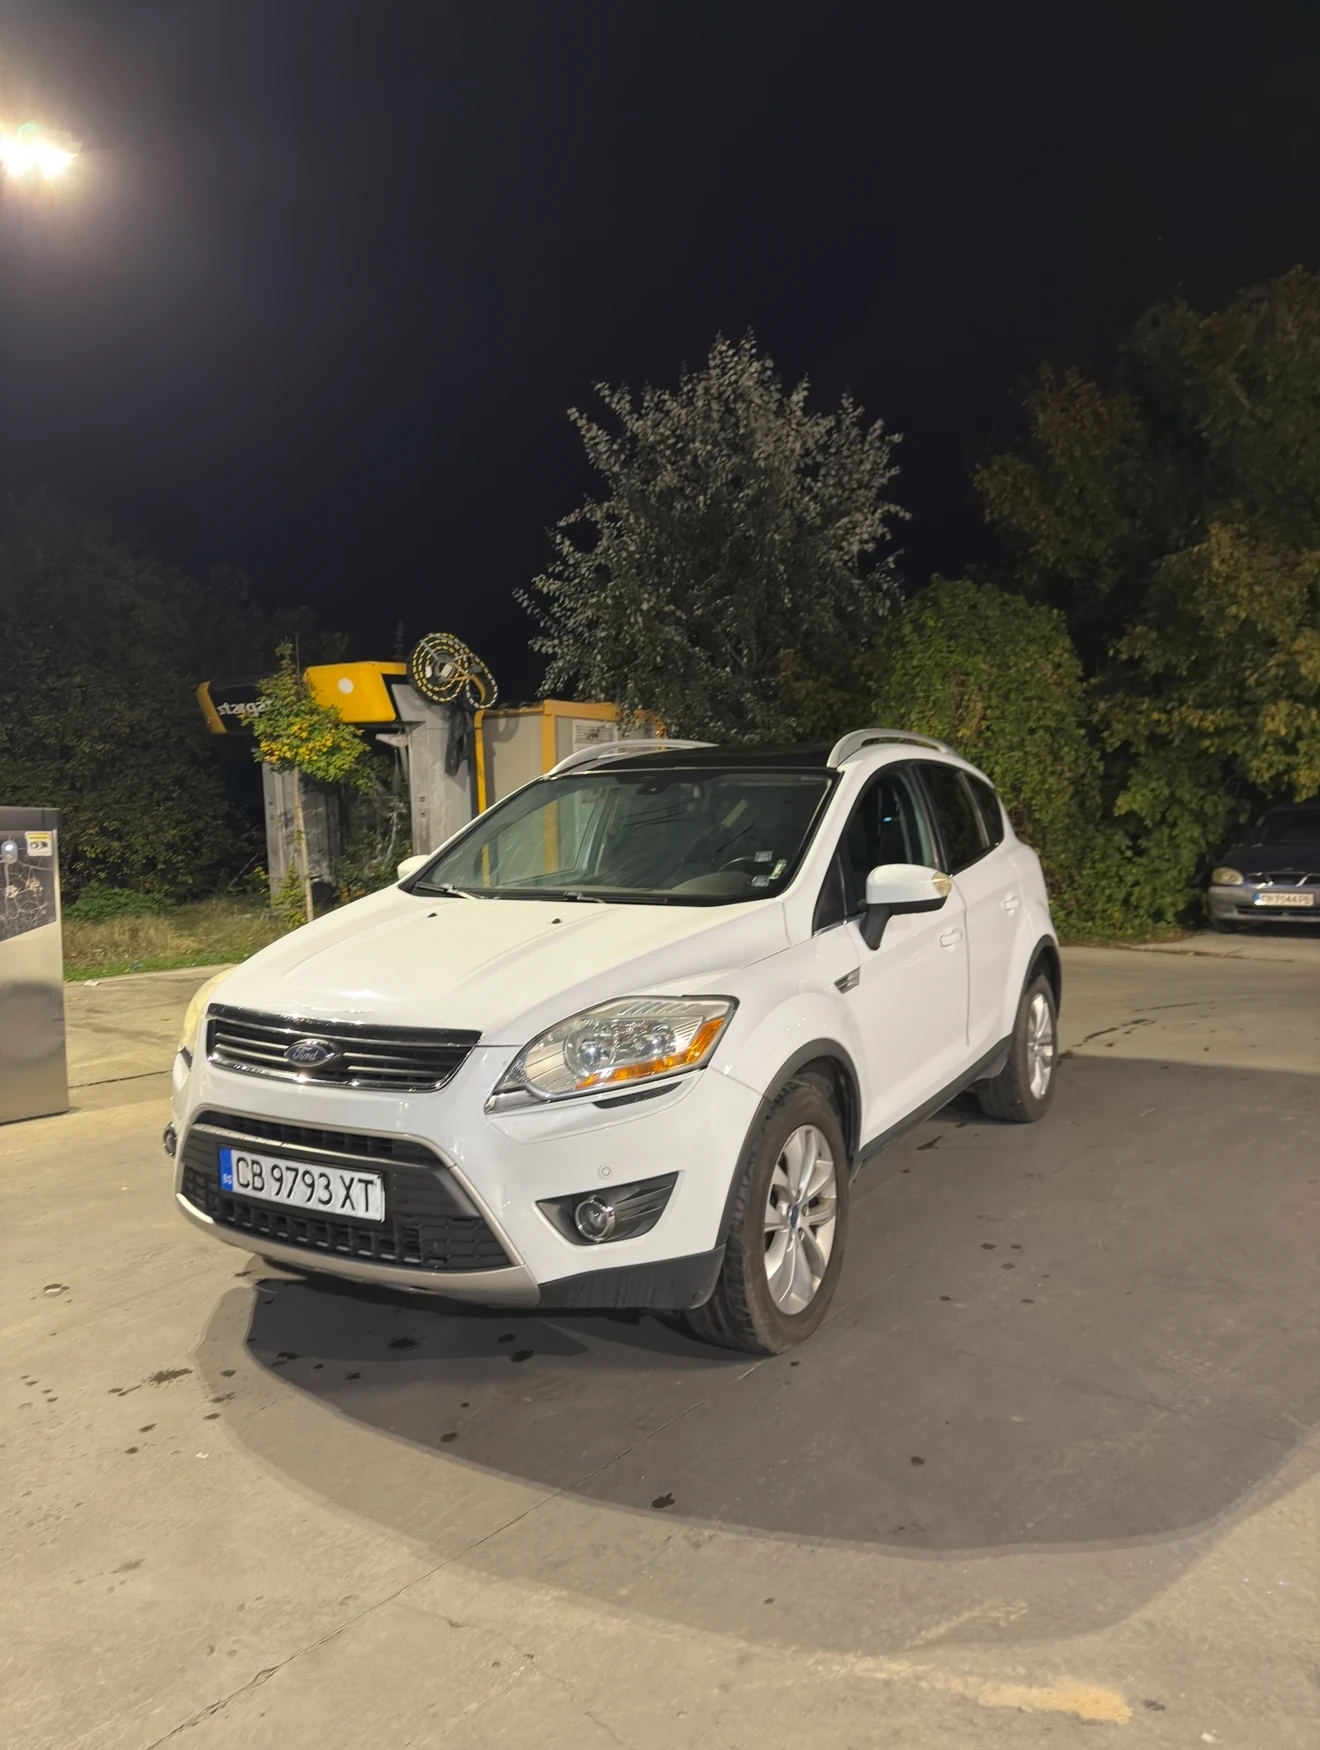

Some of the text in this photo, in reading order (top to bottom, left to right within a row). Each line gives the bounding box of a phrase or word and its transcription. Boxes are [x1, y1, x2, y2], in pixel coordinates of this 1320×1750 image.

[217, 700, 268, 718] starga
[292, 1046, 319, 1062] Ford
[236, 1156, 374, 1213] CB 9793 XT
